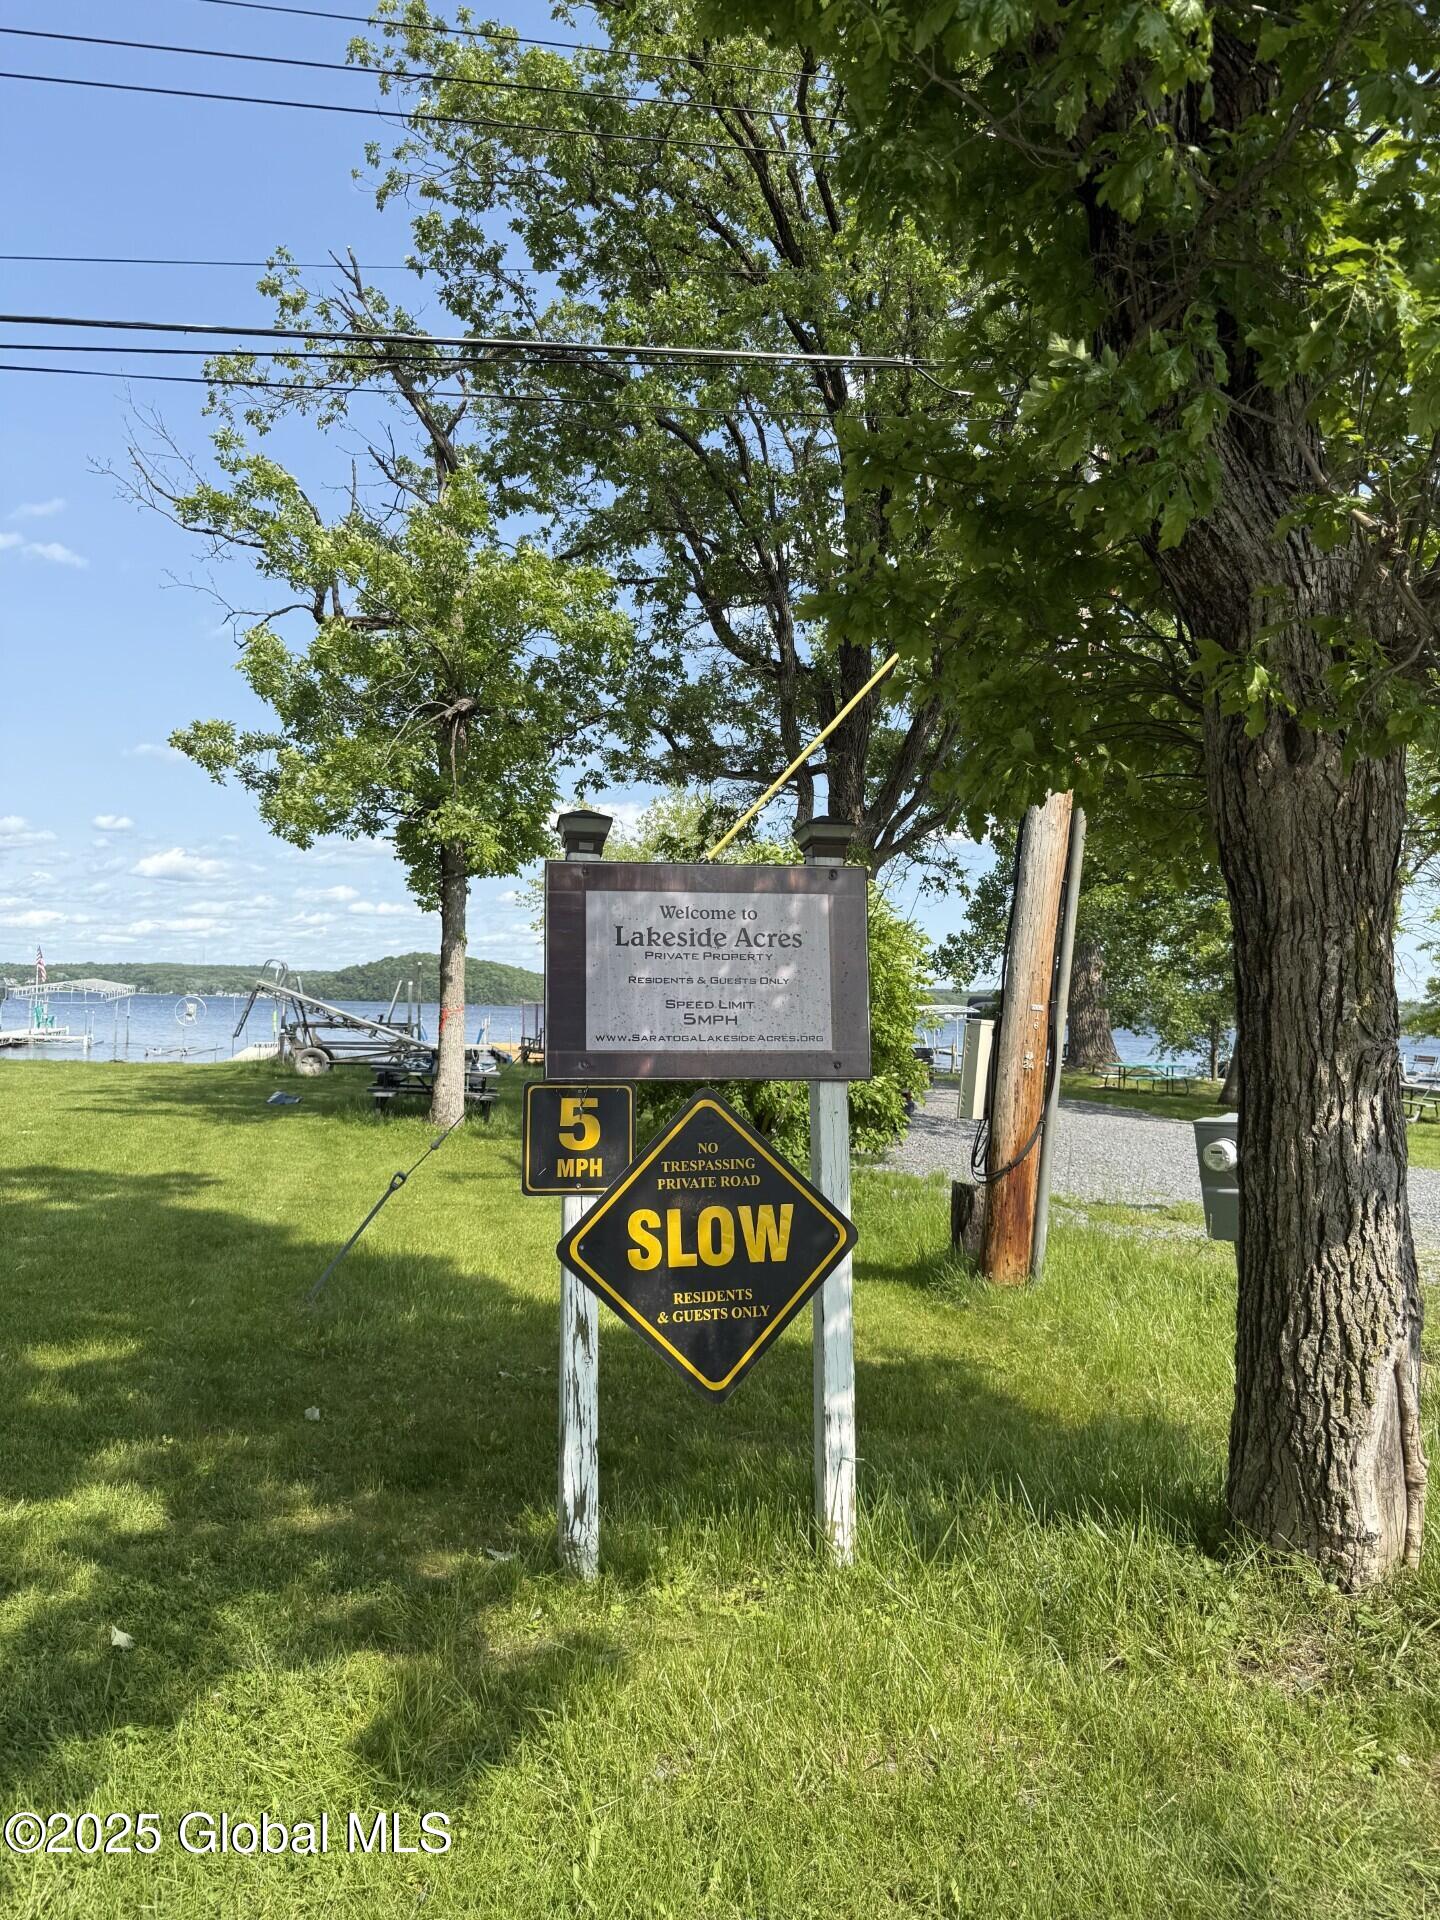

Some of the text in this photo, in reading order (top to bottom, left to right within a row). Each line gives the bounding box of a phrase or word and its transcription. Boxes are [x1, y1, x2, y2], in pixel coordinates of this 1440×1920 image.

[660, 905, 757, 920] Welcome to
[615, 925, 803, 948] Lakeside Acres
[683, 1013, 738, 1025] 5MPH
[558, 1097, 601, 1151] 5
[697, 1142, 718, 1154] NO
[556, 1158, 603, 1178] MPH
[661, 1158, 755, 1172] TRESPASSING
[657, 1175, 760, 1190] PRIVATE ROAD
[627, 1203, 794, 1271] SLOW
[673, 1289, 753, 1304] RESIDENTS
[657, 1305, 770, 1323] & GUESTS ONLY
